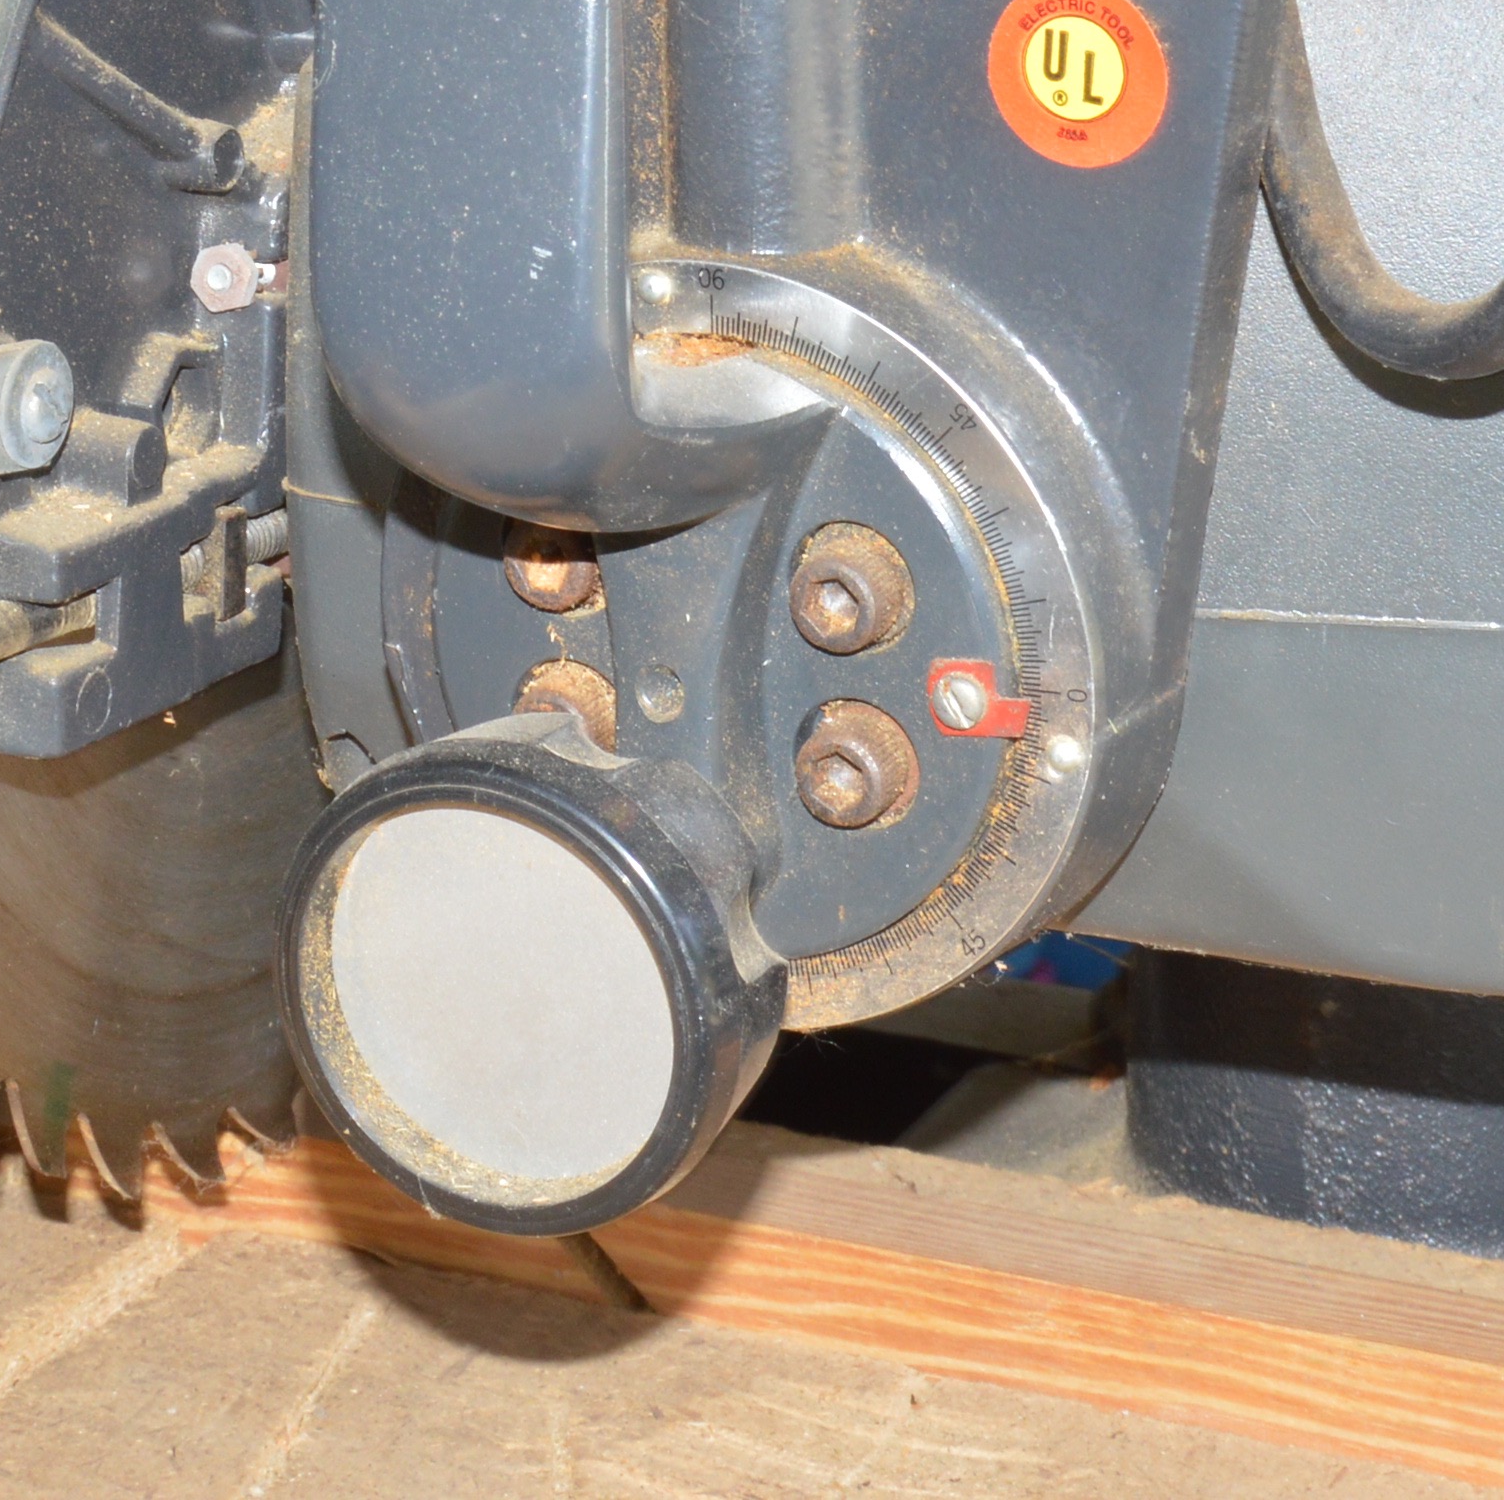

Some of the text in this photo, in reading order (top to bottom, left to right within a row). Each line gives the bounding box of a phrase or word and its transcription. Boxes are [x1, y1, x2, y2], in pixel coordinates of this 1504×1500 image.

[1099, 5, 1135, 51] TOOL
[1043, 27, 1104, 106] UL
[949, 403, 977, 430] 45
[1067, 689, 1087, 703] 0
[961, 928, 985, 956] 45
